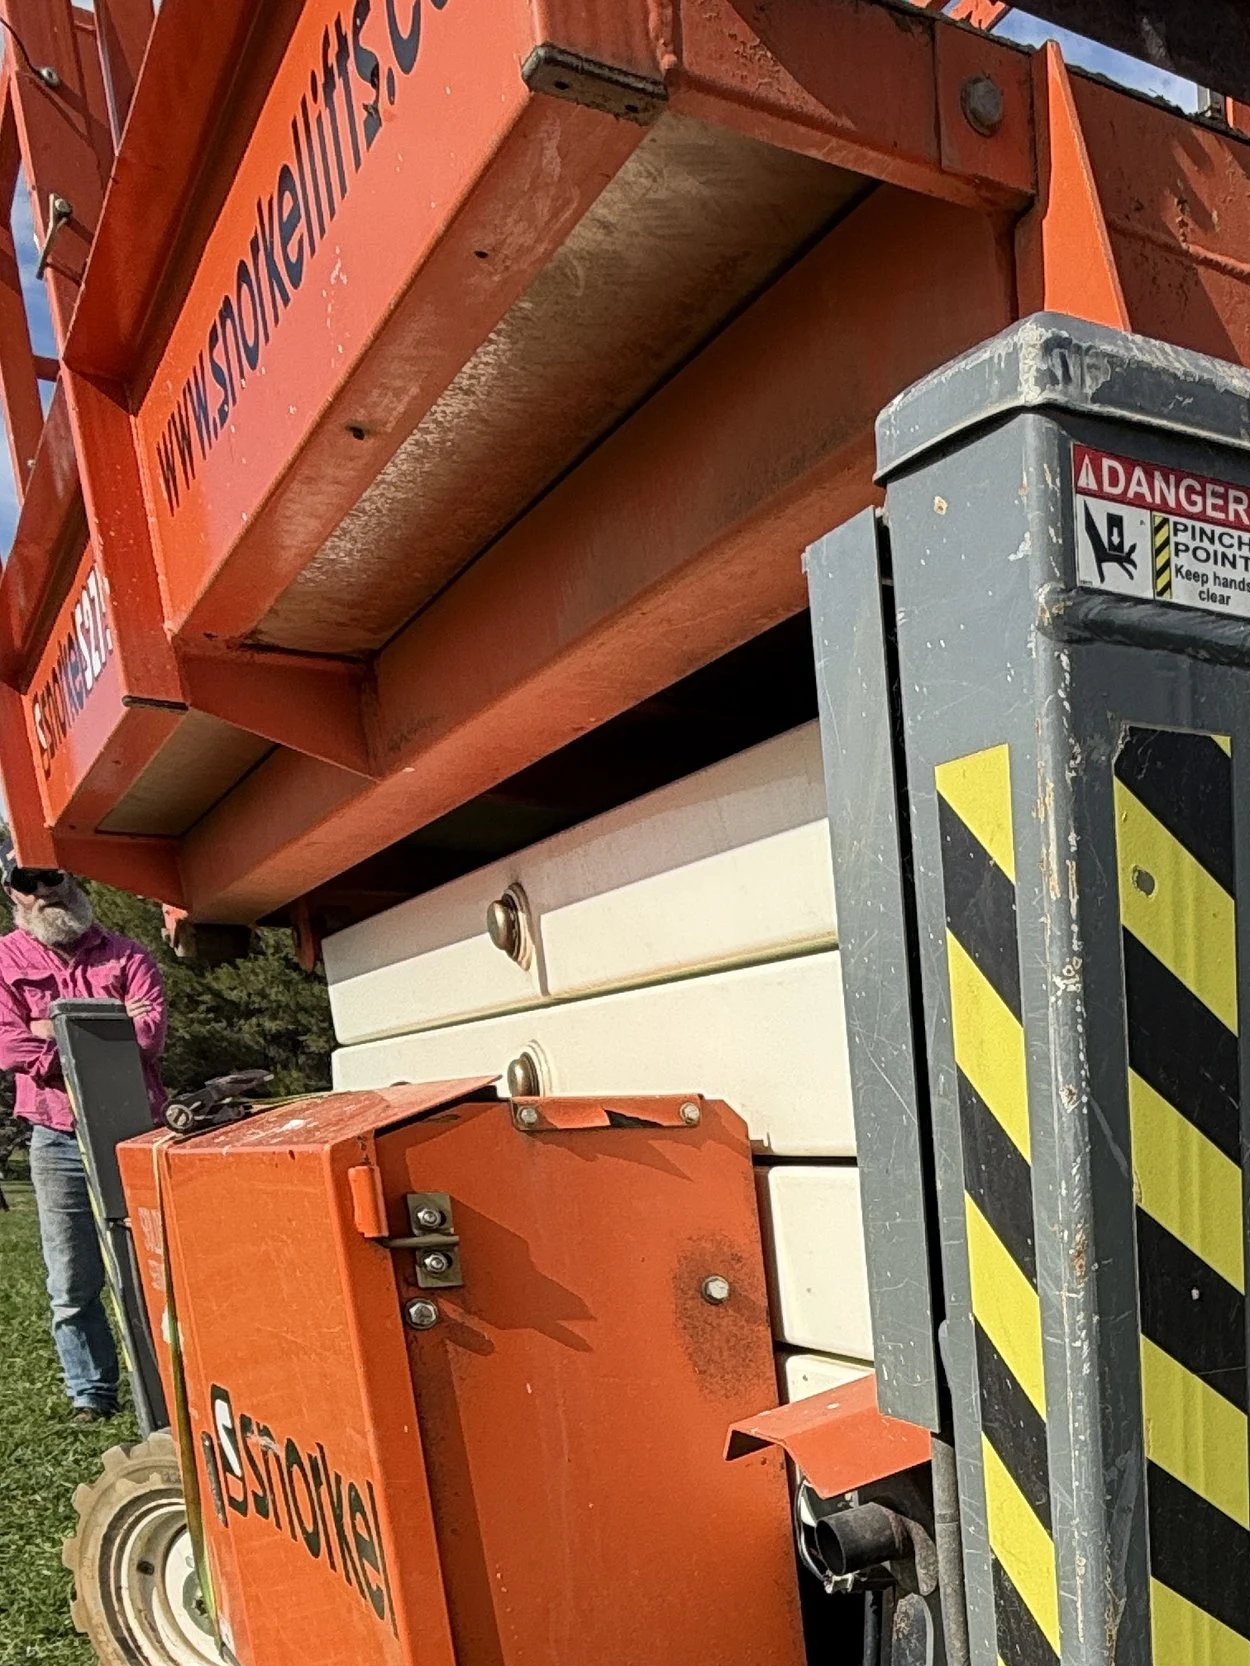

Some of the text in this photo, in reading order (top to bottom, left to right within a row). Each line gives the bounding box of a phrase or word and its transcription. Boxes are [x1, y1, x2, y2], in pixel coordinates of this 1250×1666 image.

[155, 0, 448, 517] www.snorkellifts.c
[1102, 458, 1250, 525] DANGER
[1175, 564, 1209, 585] Keep
[1198, 588, 1231, 607] clear
[240, 1413, 399, 1640] snorkel
